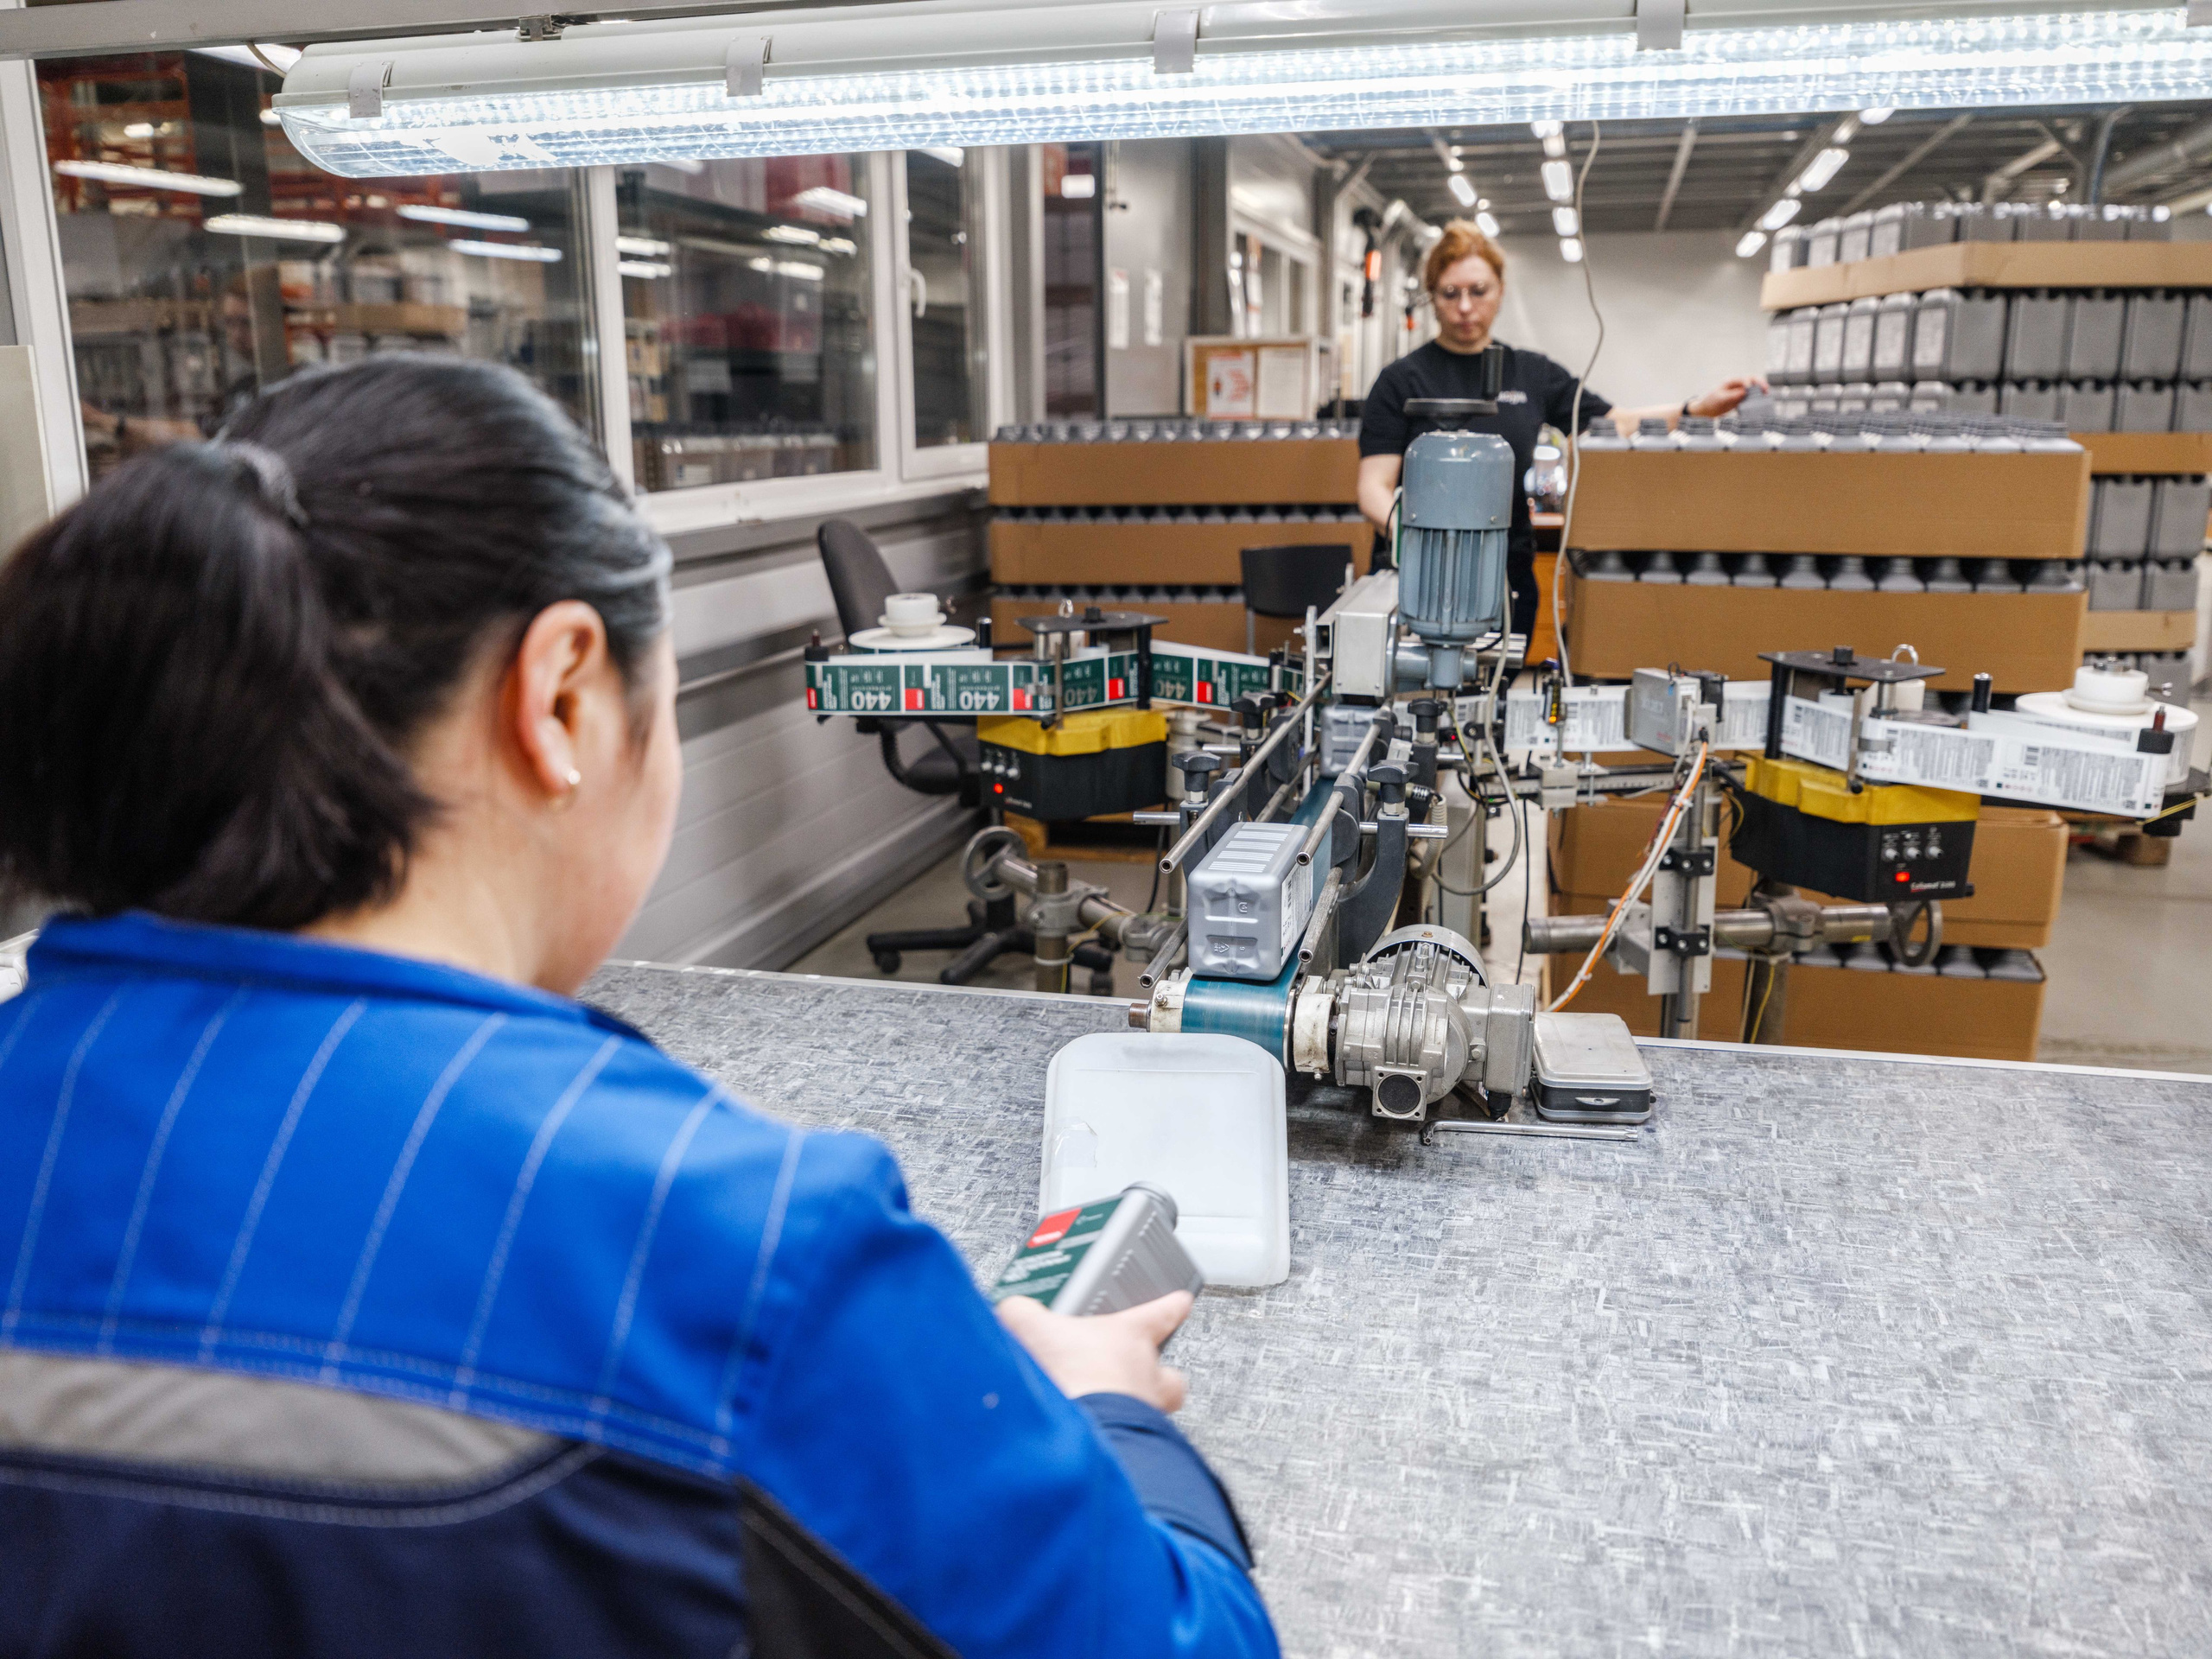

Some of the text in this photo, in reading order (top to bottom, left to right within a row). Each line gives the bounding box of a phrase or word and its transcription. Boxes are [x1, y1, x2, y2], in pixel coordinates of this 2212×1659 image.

[851, 691, 892, 710] 440
[959, 691, 1000, 710] 440
[1065, 687, 1098, 707] 440
